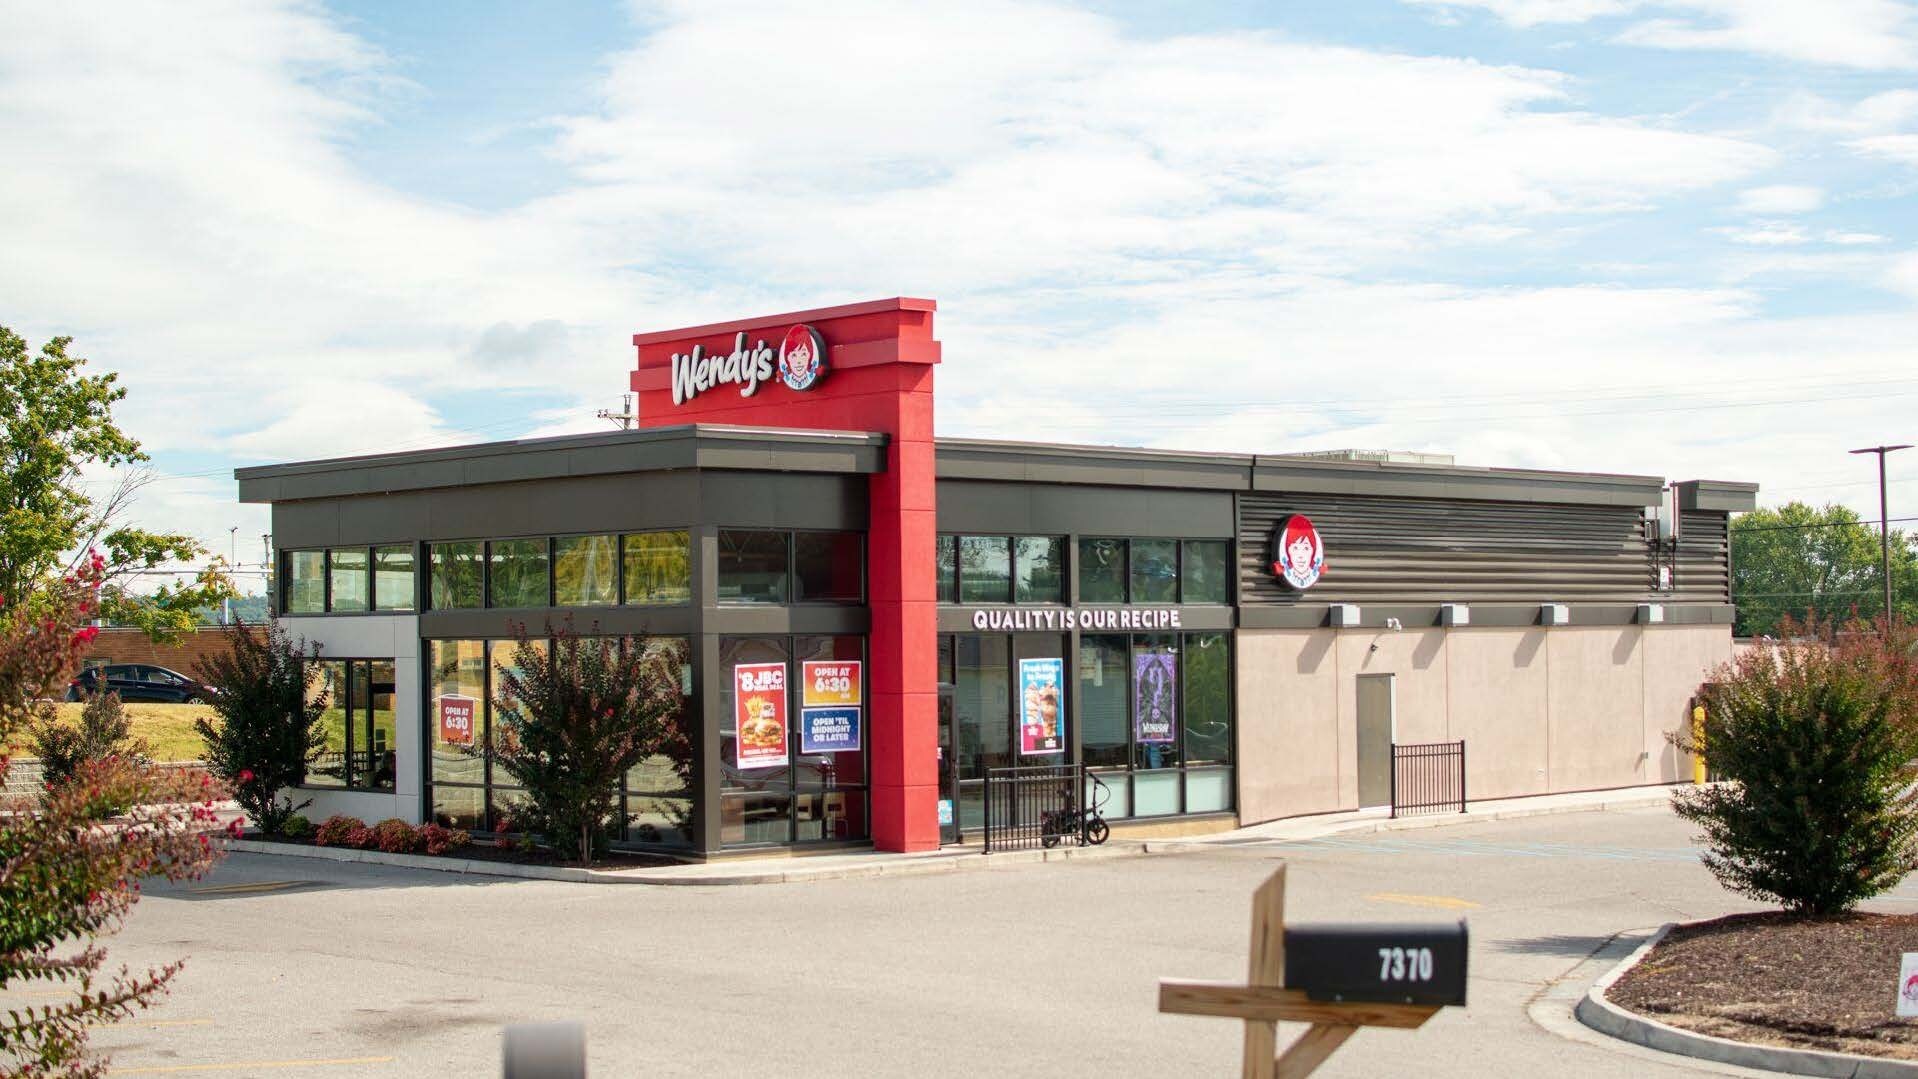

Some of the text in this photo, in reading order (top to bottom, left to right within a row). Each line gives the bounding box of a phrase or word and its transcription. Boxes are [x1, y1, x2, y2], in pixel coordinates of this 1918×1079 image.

[671, 331, 773, 406] Wendy's
[973, 609, 1182, 630] QUALITY IS OUR RECIPE
[754, 670, 783, 685] JBC
[815, 667, 851, 676] OPEN AT
[815, 677, 850, 692] 6:30
[445, 706, 469, 715] OPEN AT
[446, 716, 468, 729] 6:30
[813, 717, 834, 726] OPEN
[811, 725, 851, 734] MIDNIGHT
[813, 733, 849, 742] OR LATER
[1378, 947, 1433, 982] 7370
